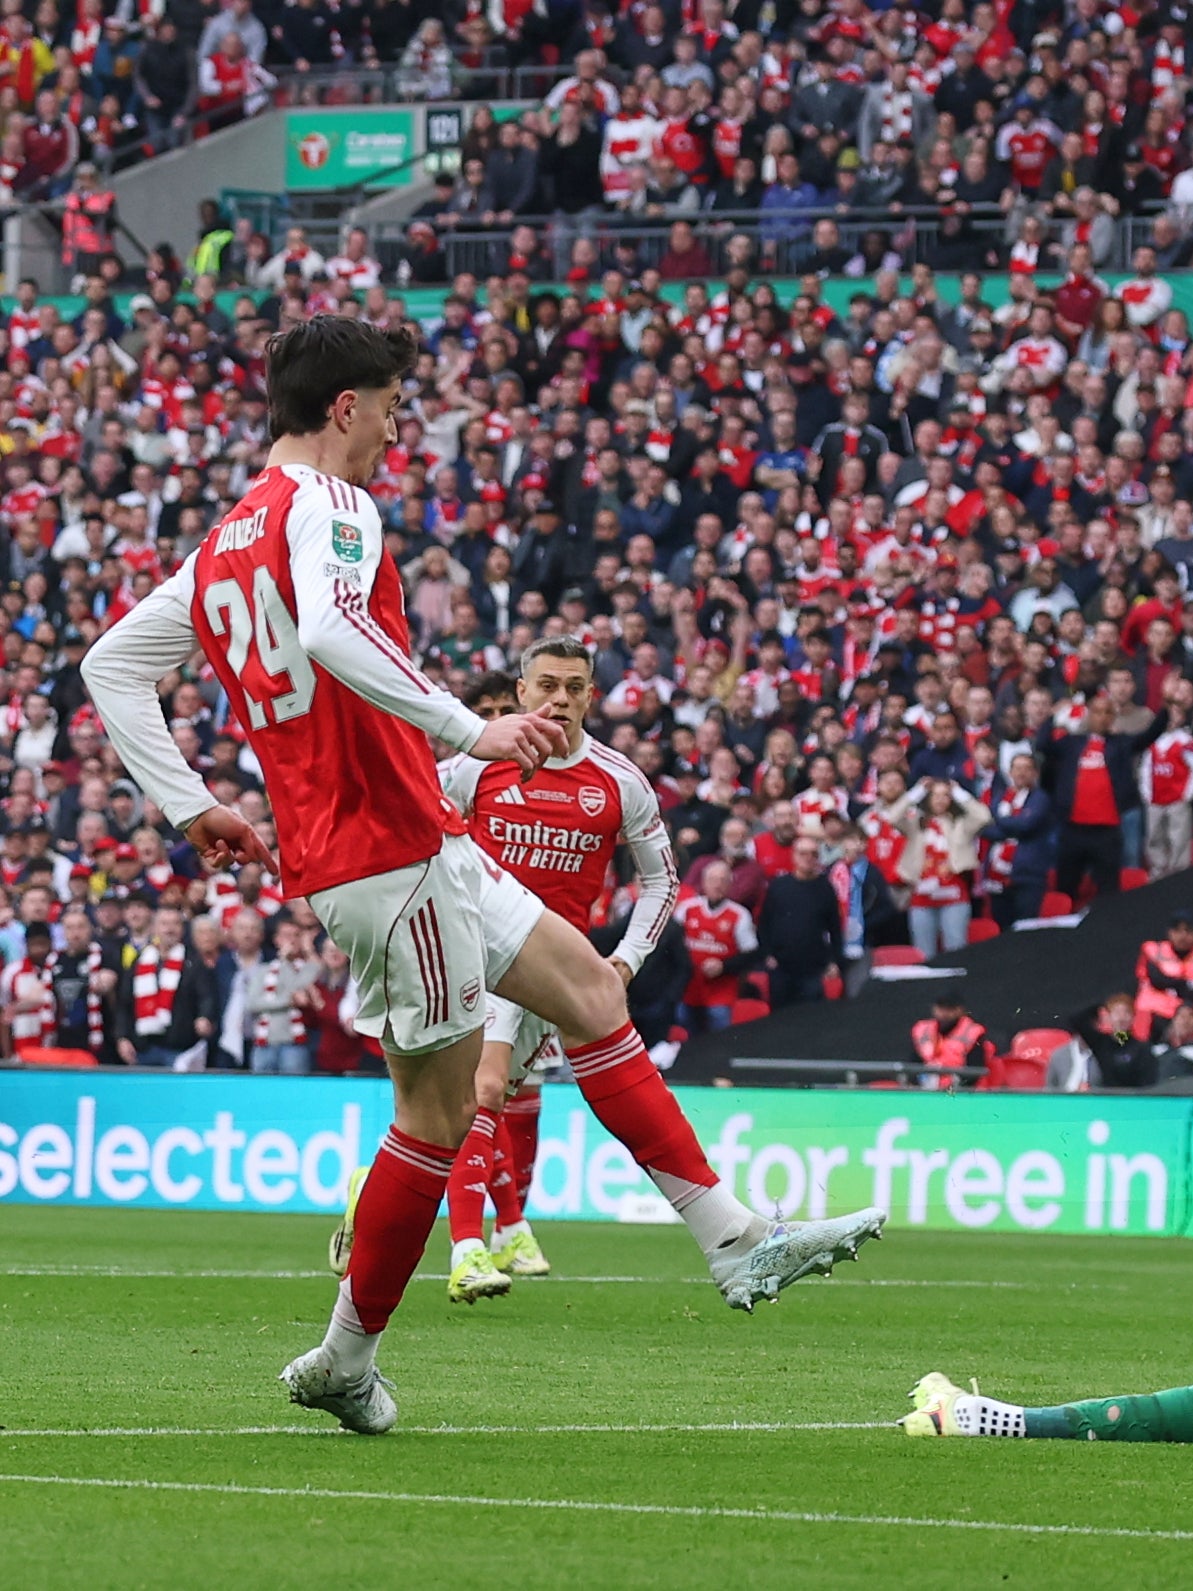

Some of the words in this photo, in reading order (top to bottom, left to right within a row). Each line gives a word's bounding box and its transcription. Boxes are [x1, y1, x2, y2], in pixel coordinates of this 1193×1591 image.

[489, 816, 603, 852] Emirates
[501, 843, 527, 865] FLY
[529, 848, 584, 873] BETTER
[709, 1114, 847, 1221] for
[862, 1117, 1065, 1228] free
[1084, 1121, 1166, 1229] in
